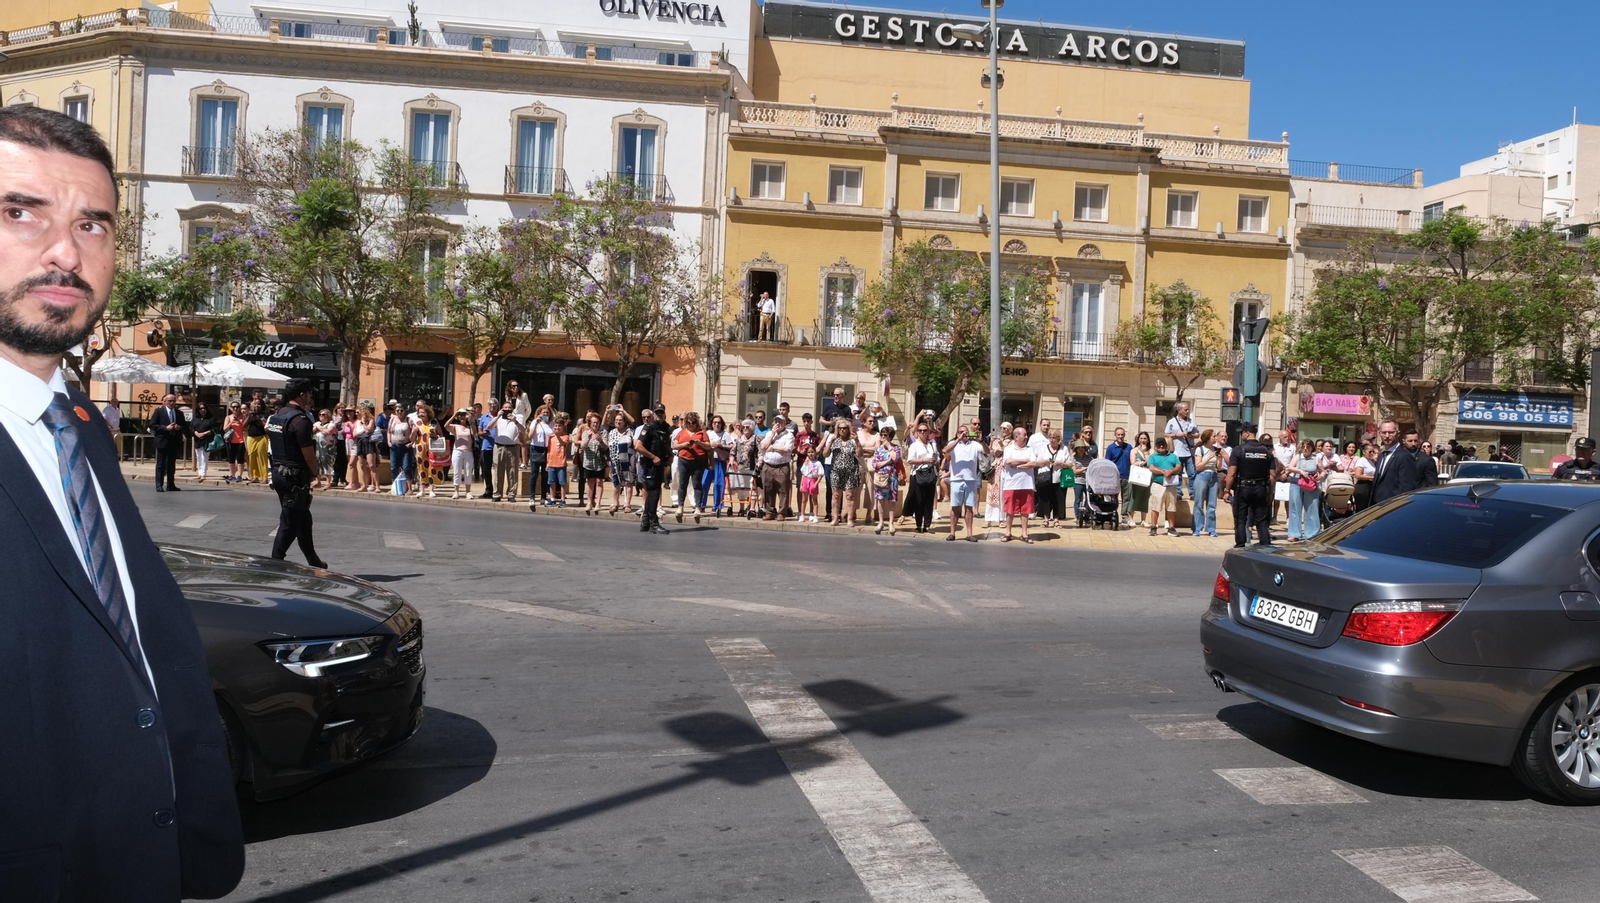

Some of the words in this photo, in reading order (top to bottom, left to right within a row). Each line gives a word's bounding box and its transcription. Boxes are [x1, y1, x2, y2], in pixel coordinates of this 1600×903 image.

[599, 0, 725, 22] OLIVENCIA
[1058, 33, 1179, 65] ARCOS
[273, 342, 296, 358] Jr.
[255, 361, 294, 369] BURGERS
[295, 362, 314, 370] 1941
[1000, 367, 1029, 376] LE-HOP
[1315, 397, 1333, 407] BAO
[1335, 398, 1357, 408] NAILS
[1463, 400, 1486, 410] SE
[1491, 402, 1570, 414] ALQUILA
[1463, 410, 1493, 419] 606
[1498, 411, 1518, 421] 98
[1523, 413, 1543, 422] 05
[1549, 414, 1568, 423] 55
[1256, 600, 1287, 621] 8362
[1288, 608, 1315, 630] GBH
